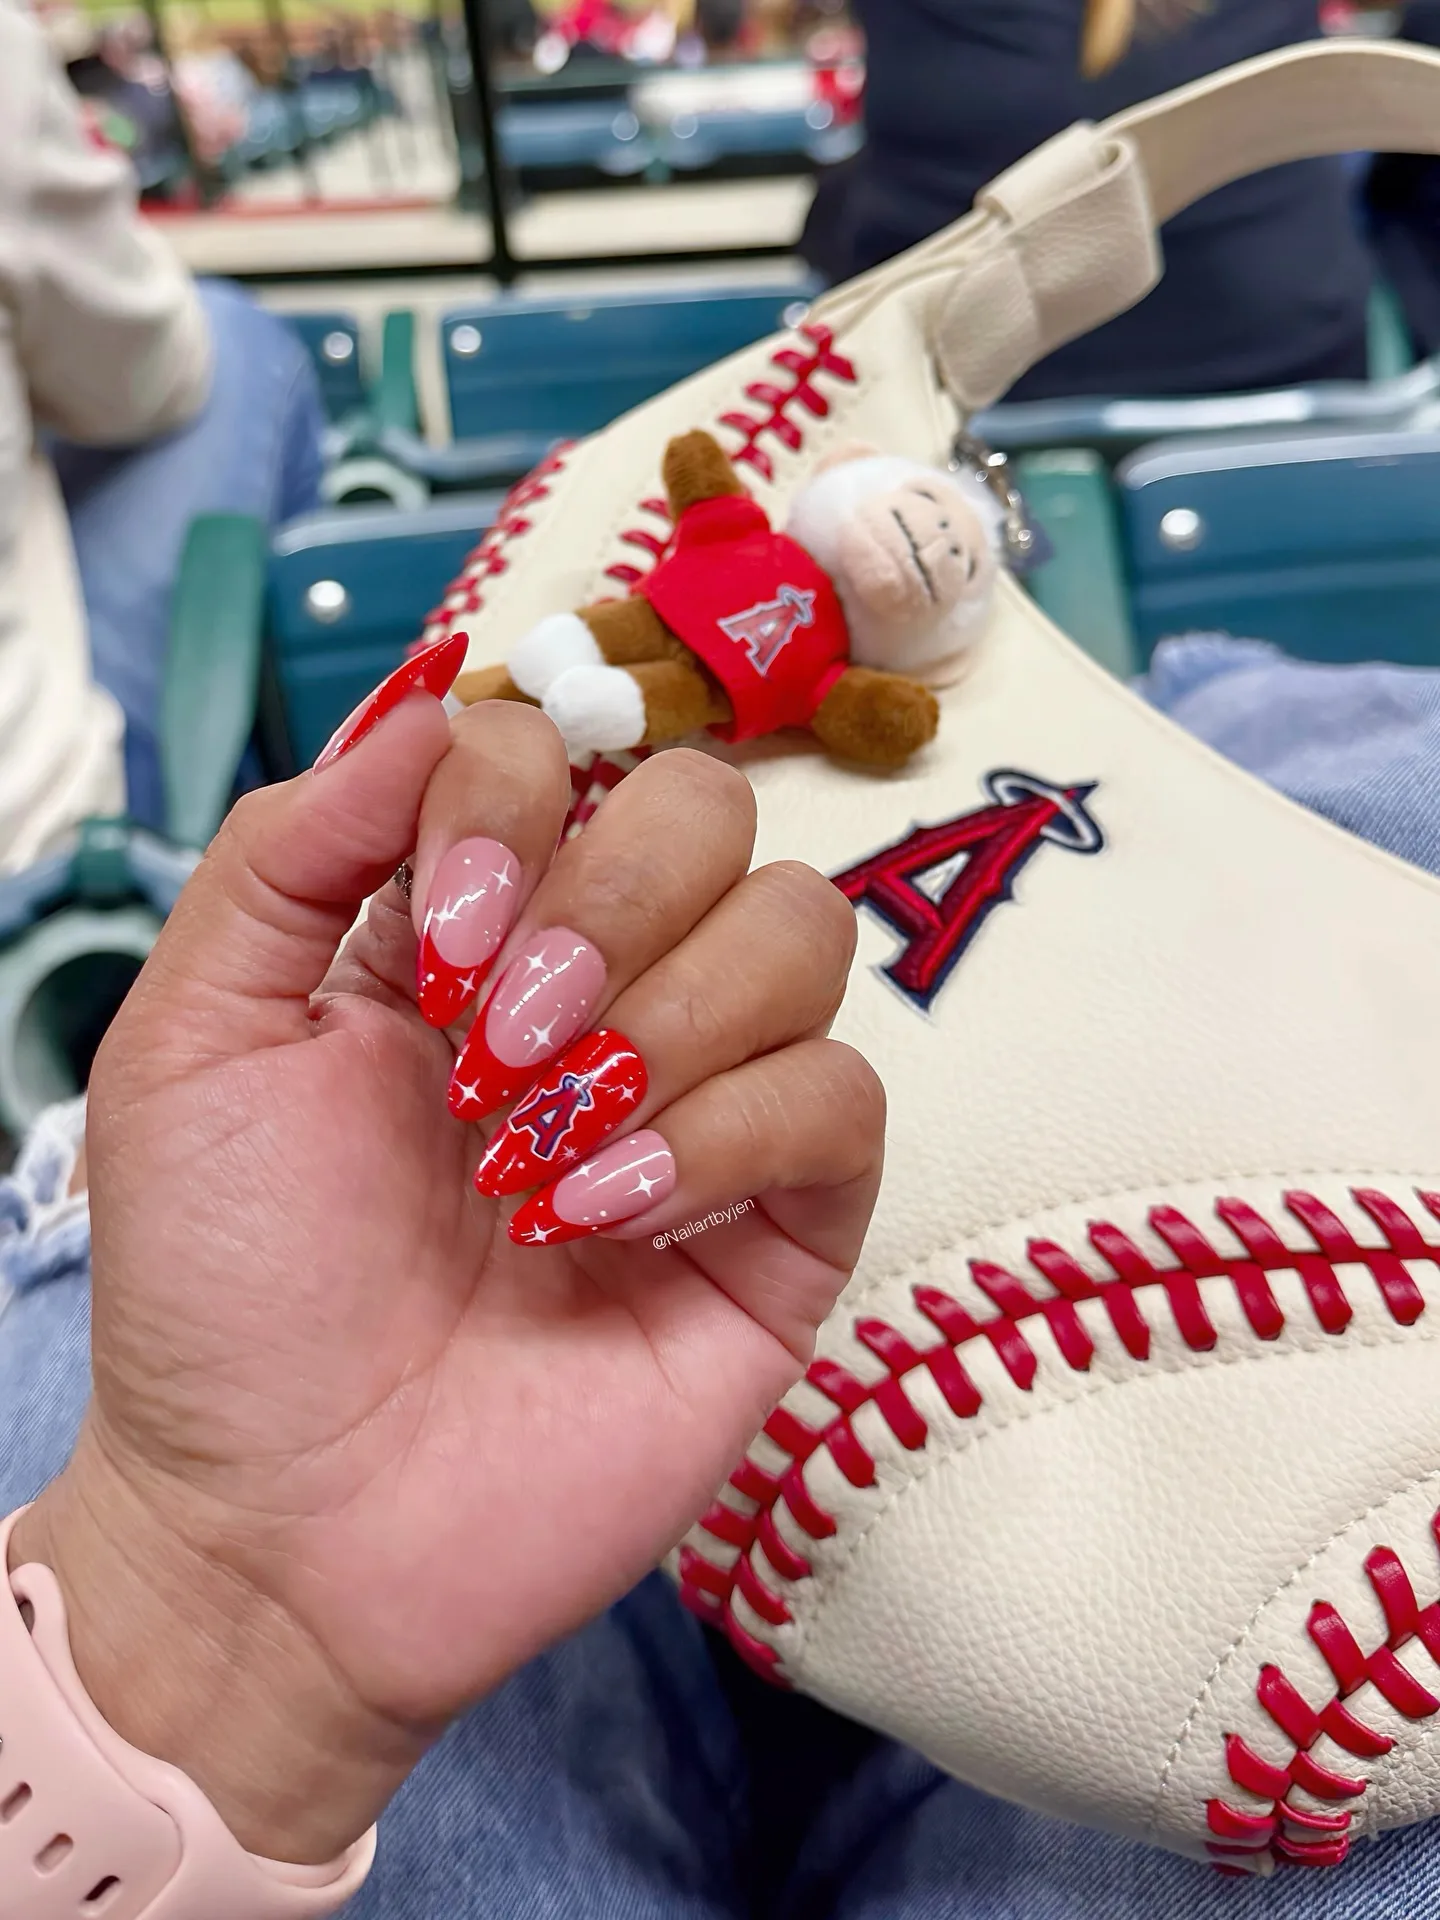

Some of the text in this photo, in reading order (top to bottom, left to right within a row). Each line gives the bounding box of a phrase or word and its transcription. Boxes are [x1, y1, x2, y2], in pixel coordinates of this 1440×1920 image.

[717, 583, 815, 676] A
[828, 768, 1104, 1014] A
[507, 1072, 595, 1161] A
